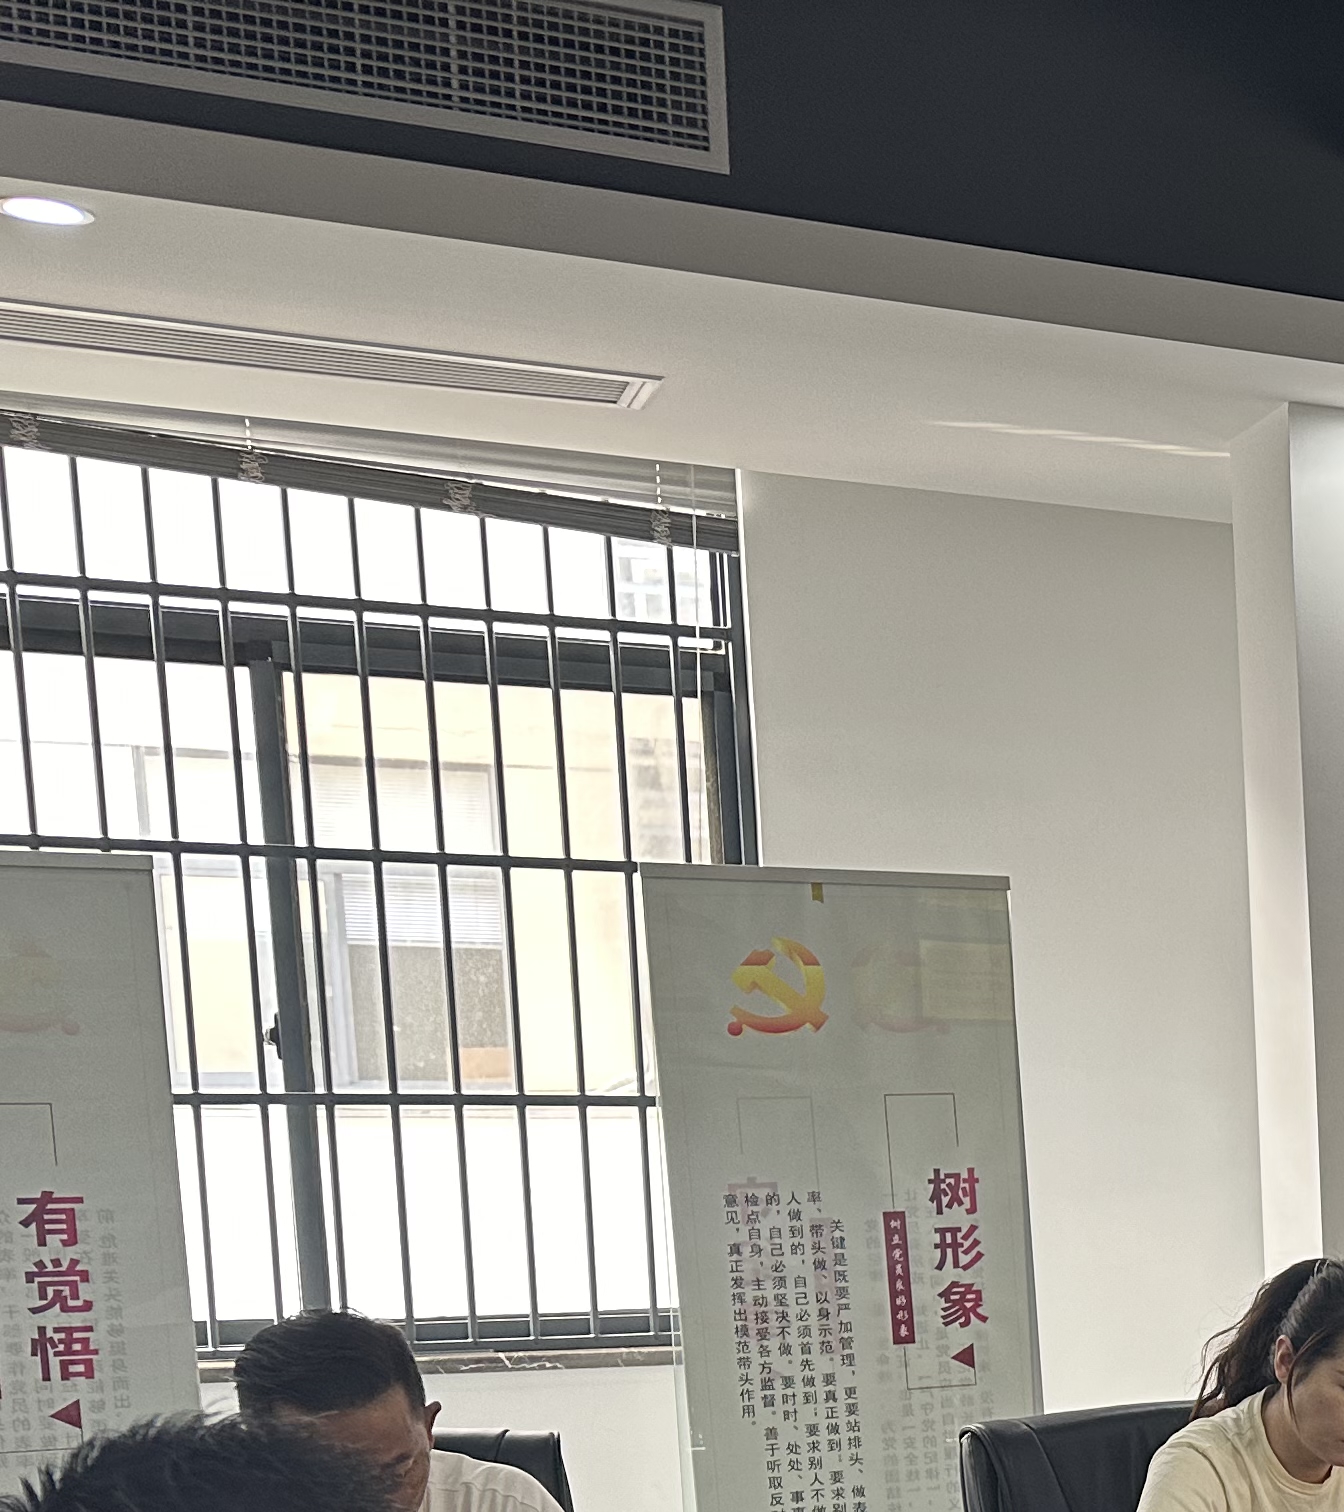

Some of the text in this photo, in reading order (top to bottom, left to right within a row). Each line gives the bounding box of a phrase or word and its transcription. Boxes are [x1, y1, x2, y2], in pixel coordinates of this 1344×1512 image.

[16, 1190, 99, 1382] 有觉悟
[928, 1167, 989, 1329] 树形象
